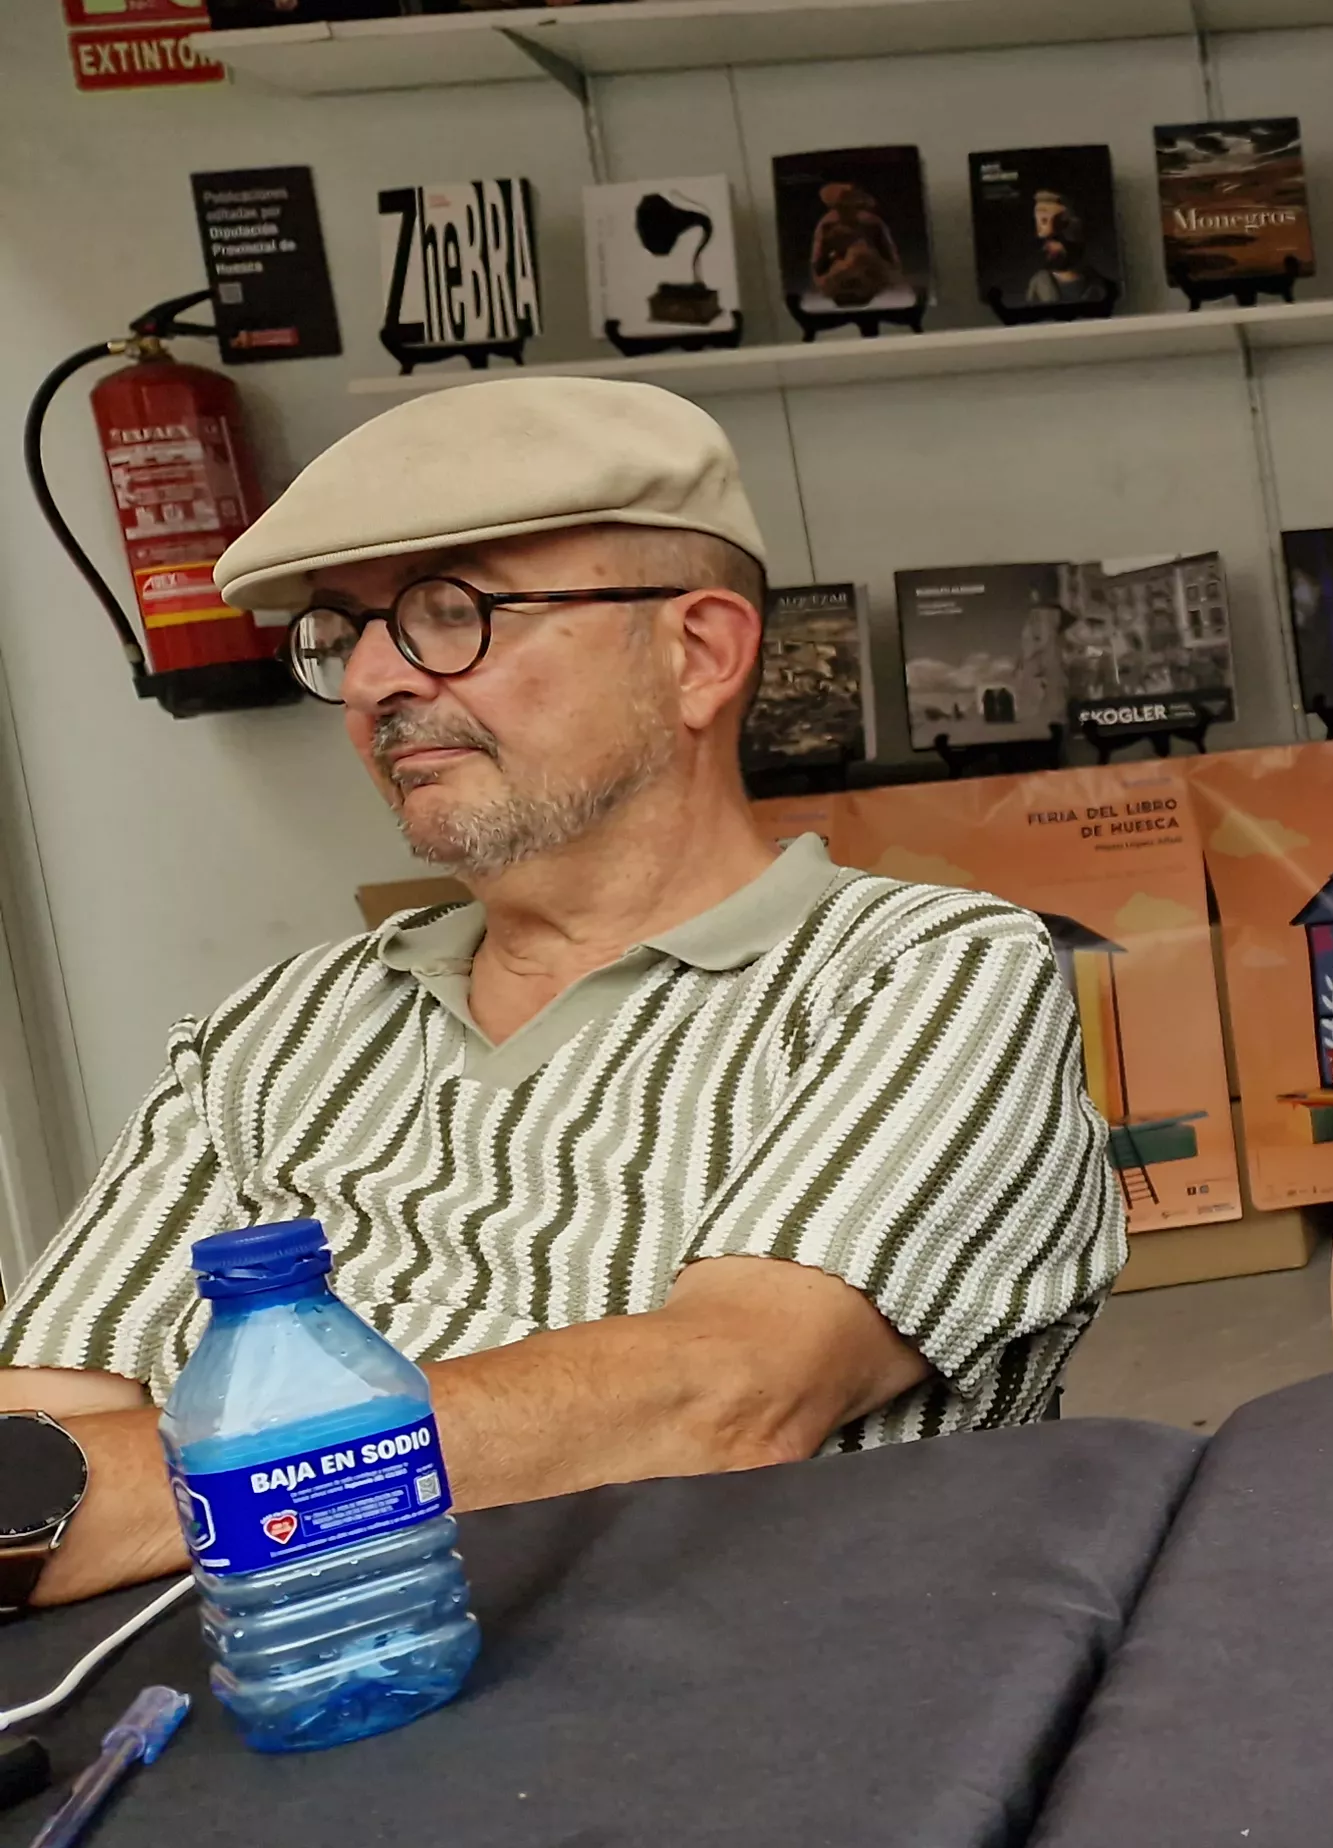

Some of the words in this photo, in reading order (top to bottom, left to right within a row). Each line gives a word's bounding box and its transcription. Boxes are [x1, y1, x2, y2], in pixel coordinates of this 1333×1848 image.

[1174, 207, 1296, 233] Monegros
[1027, 810, 1078, 825] FERIA
[1086, 806, 1118, 820] DEL
[1126, 798, 1177, 816] LIBRO
[1081, 825, 1102, 838] DE
[1110, 816, 1179, 835] HUESCA
[250, 1461, 315, 1494] BAJA
[320, 1450, 355, 1475] EN
[361, 1427, 431, 1464] SODIO
